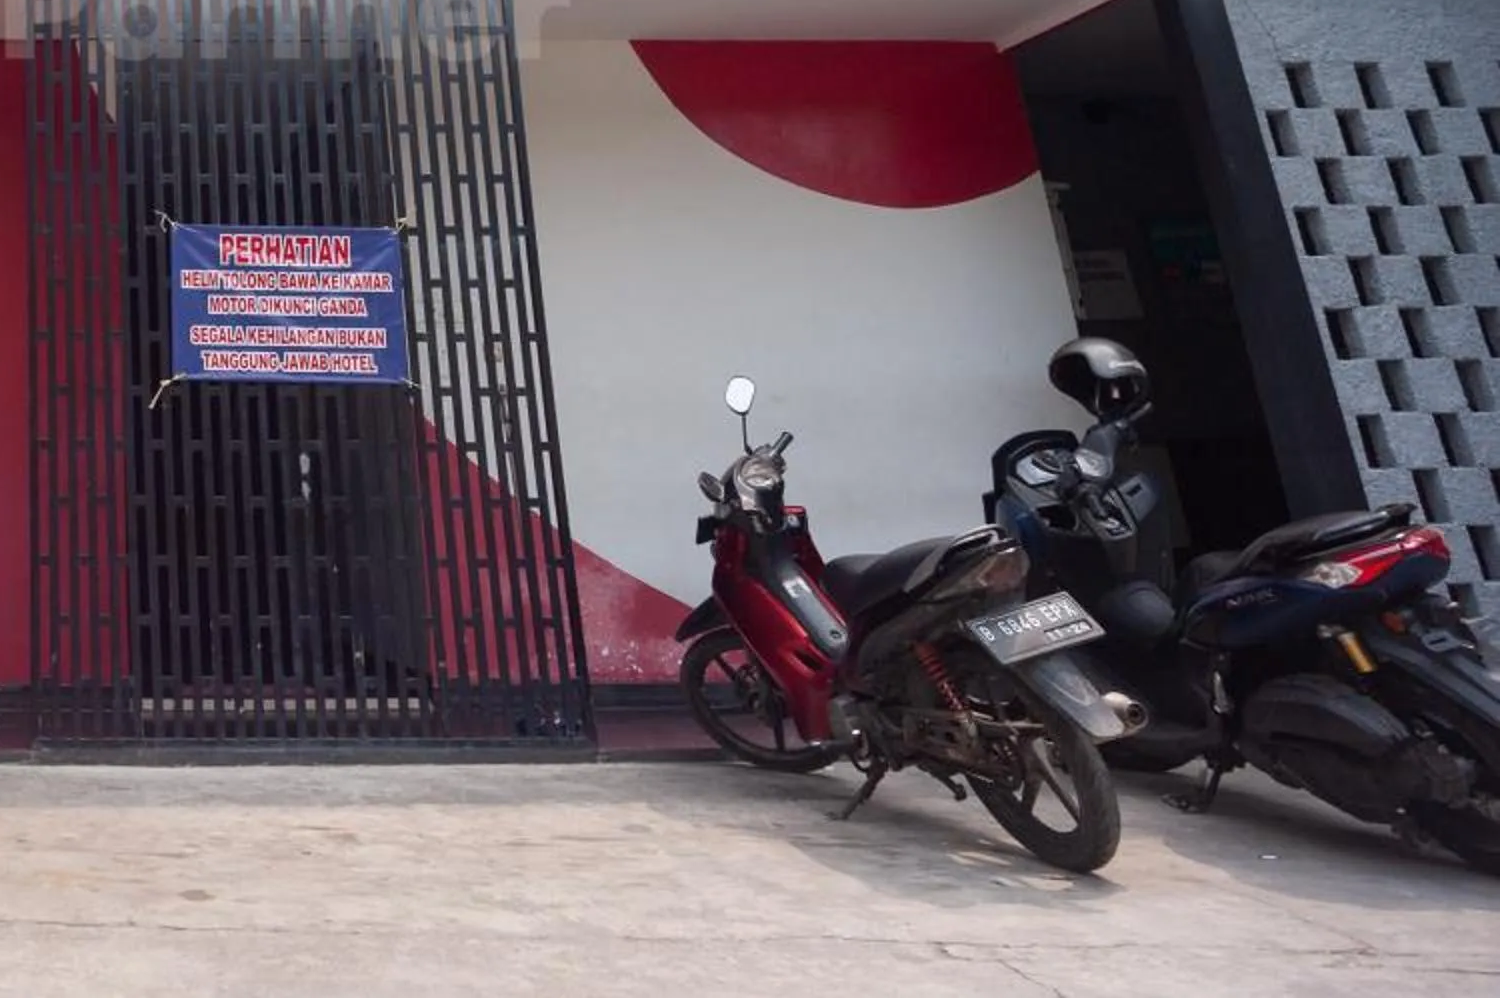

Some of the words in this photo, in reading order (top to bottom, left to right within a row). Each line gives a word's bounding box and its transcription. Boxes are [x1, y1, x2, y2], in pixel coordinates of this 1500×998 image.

[220, 234, 350, 266] PERHATIAN
[182, 270, 220, 289] HELM
[222, 271, 277, 291] TOLONG
[278, 272, 318, 292] BAWA
[320, 272, 341, 292] KE
[341, 272, 393, 292] KAMAR
[208, 296, 256, 314] MOTOR
[258, 296, 317, 316] DIKUNCI
[319, 297, 367, 317] GANDA
[190, 326, 244, 345] SEGALA
[246, 326, 337, 347] KEHILANGAN
[338, 328, 386, 348] BUKAN
[202, 350, 280, 372] TANGGUNG
[281, 352, 330, 373] JAWAB
[330, 353, 378, 374] HOTEL
[979, 624, 995, 641] B
